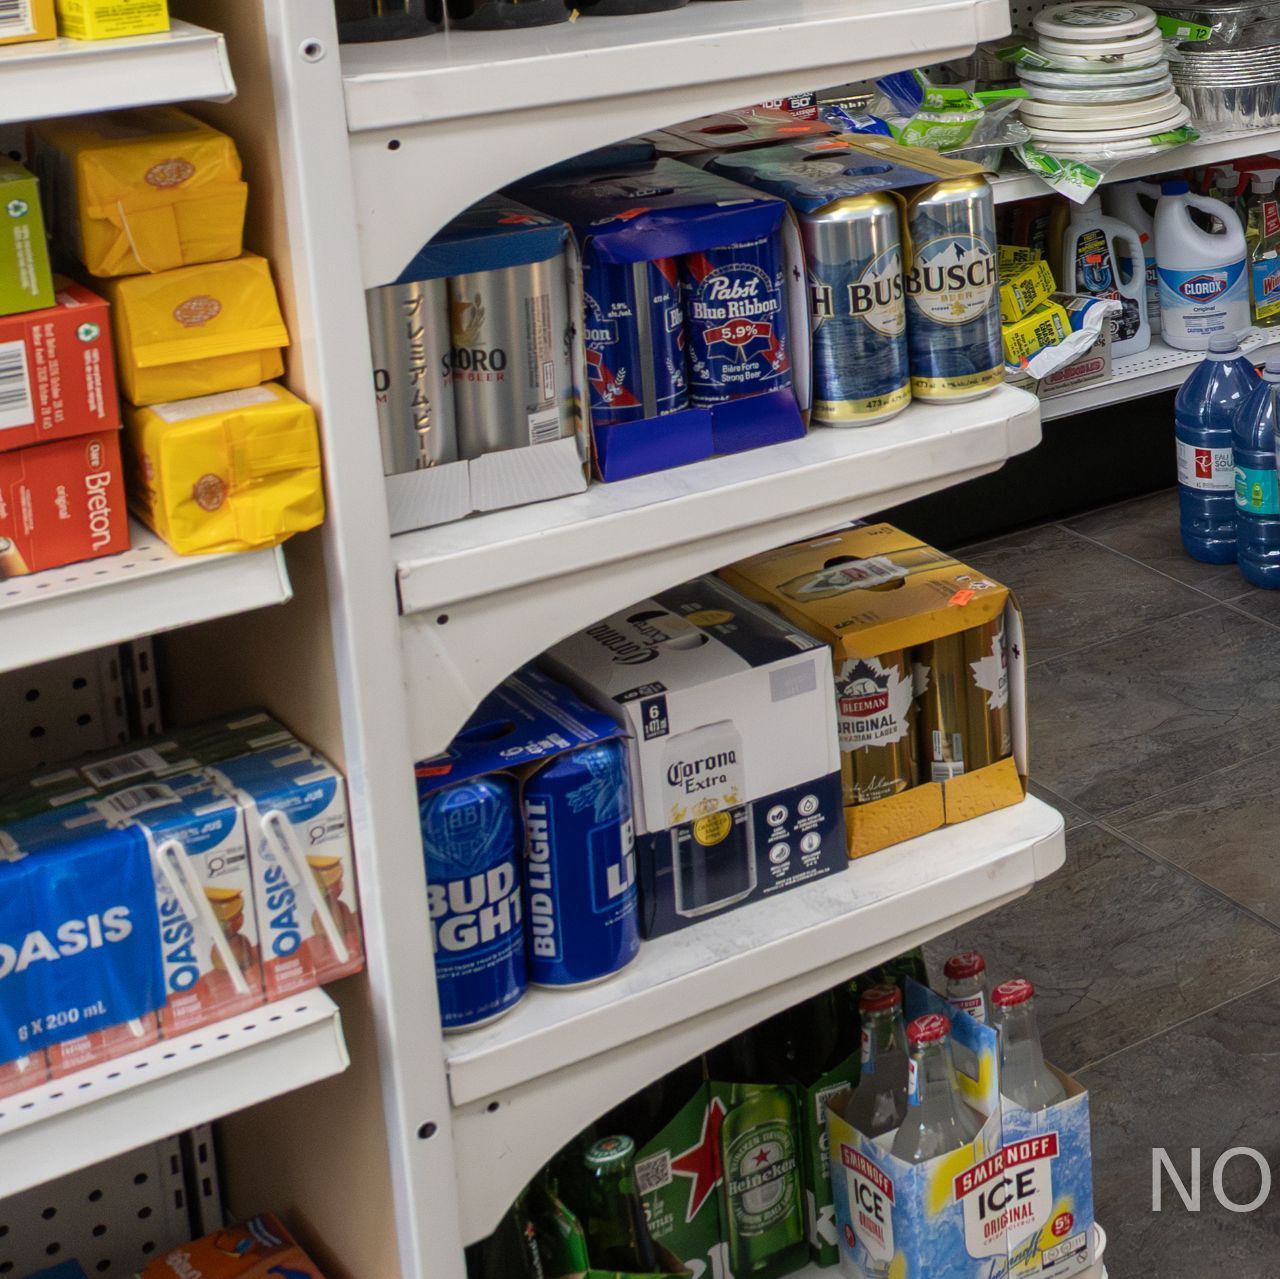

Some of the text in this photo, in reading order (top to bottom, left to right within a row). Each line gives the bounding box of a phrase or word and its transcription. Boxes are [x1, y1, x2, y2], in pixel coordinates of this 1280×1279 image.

[709, 275, 758, 300] Pabst
[907, 253, 998, 294] BUSCH
[1184, 280, 1222, 296] CLOROX
[694, 295, 779, 319] Blue Ribbon
[85, 471, 113, 549] Breton
[666, 746, 738, 789] Corona
[685, 772, 728, 795] Extra
[526, 799, 556, 957] BUD LIGHT
[265, 865, 301, 958] OASIS
[46, 1009, 79, 1031] 200
[842, 1145, 895, 1201] SMIRNOFF
[961, 1141, 1050, 1190] SMIRNOFF
[854, 1180, 882, 1220] ICE
[978, 1168, 1038, 1219] ICE
